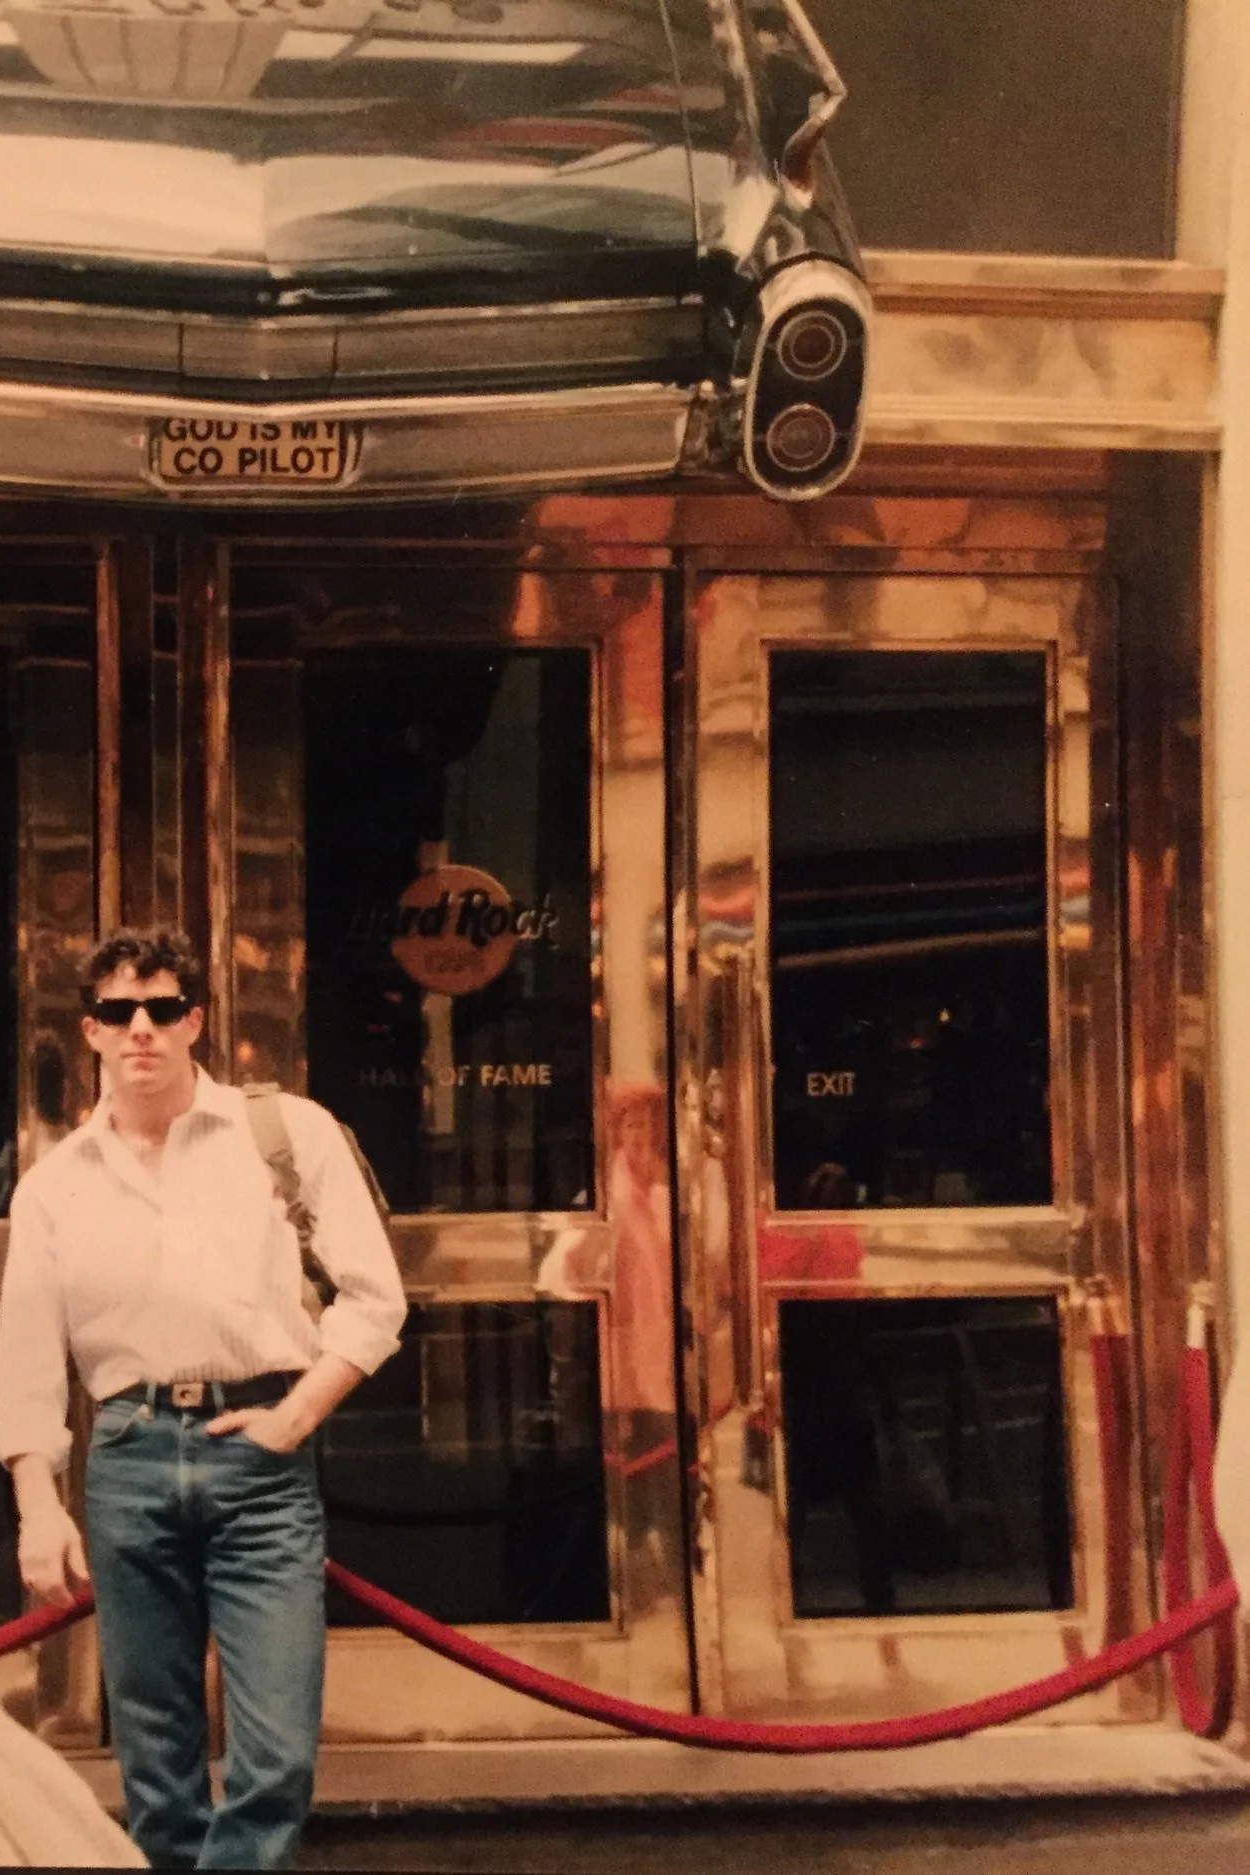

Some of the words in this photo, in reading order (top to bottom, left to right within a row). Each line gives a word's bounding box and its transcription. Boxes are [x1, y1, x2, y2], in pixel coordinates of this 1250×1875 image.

[163, 417, 238, 442] GOD
[250, 420, 281, 442] IS
[291, 420, 337, 441] MY
[173, 446, 223, 474] CO
[238, 446, 336, 474] PILOT
[455, 888, 559, 951] Rock
[357, 1066, 426, 1087] HA
[479, 1063, 553, 1087] FAME
[806, 1071, 856, 1096] EXIT
